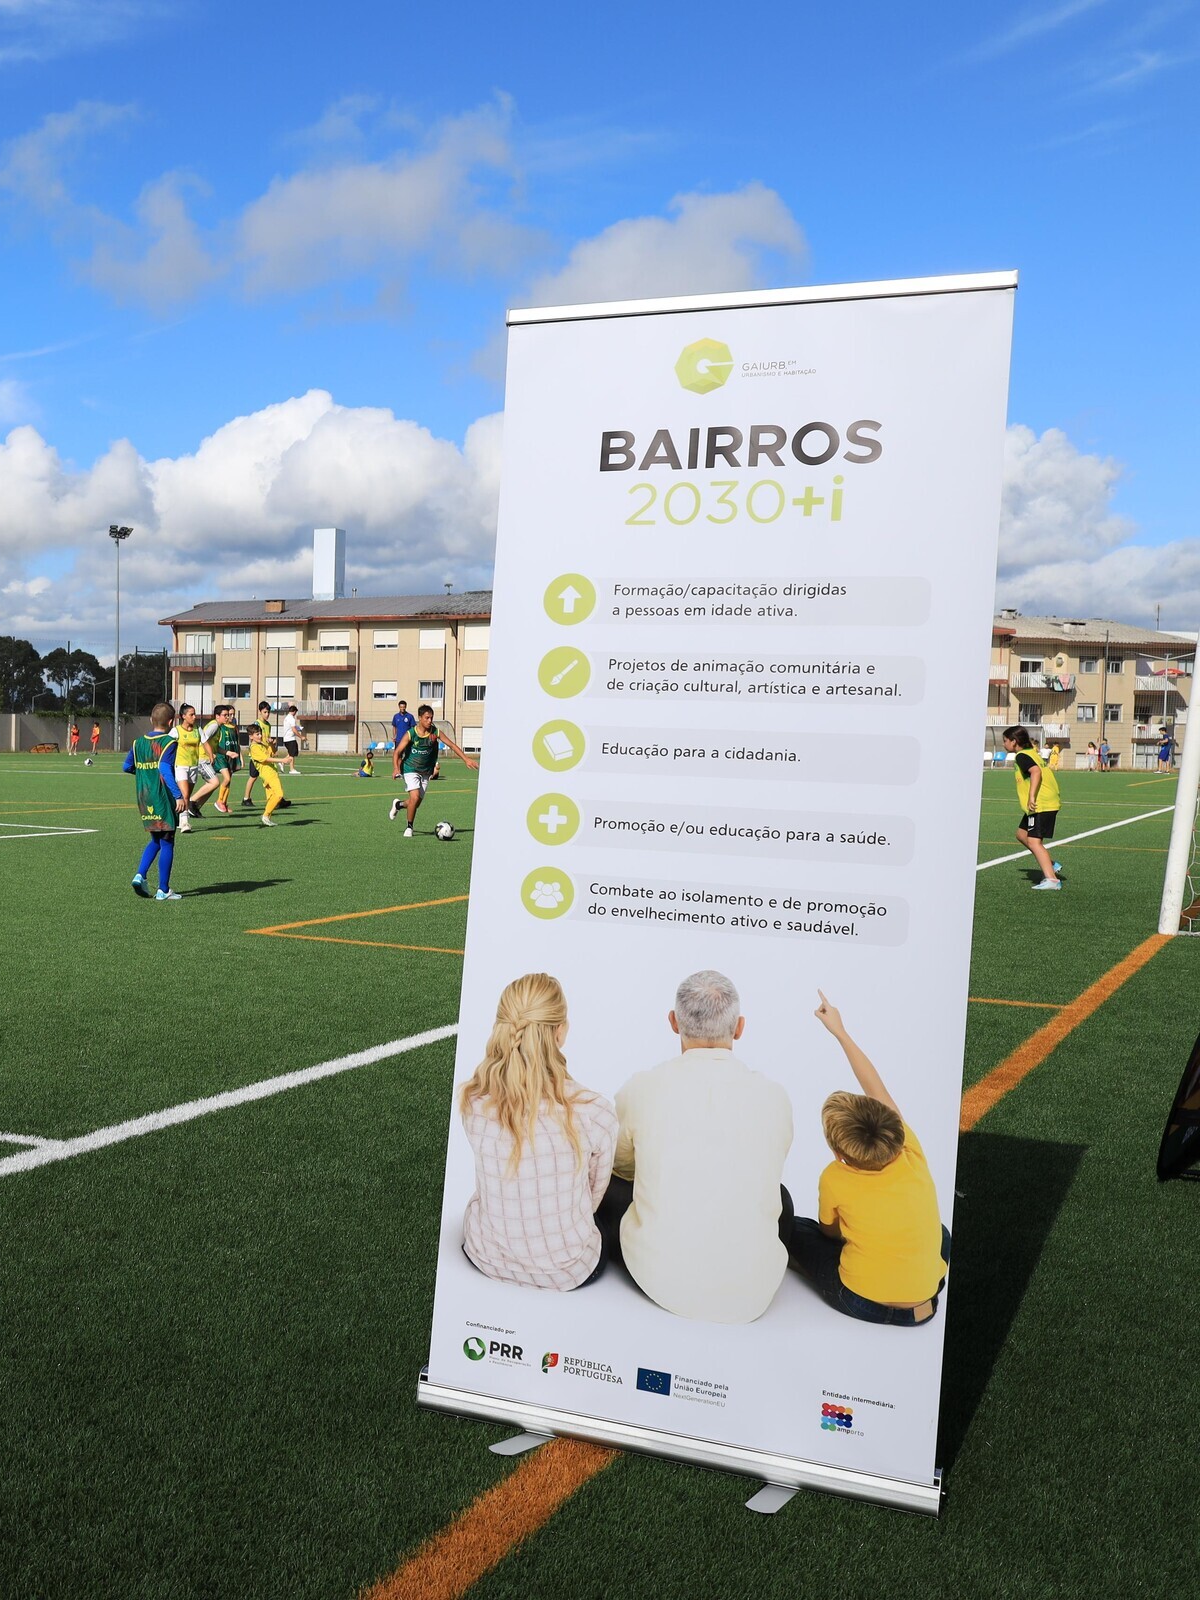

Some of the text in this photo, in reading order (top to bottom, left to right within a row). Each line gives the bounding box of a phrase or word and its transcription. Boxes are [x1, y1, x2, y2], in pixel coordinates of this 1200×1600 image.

[600, 420, 883, 472] BAIRROS
[625, 475, 844, 526] 2030+i
[614, 582, 847, 600] Formação/capacitação dirigidas
[612, 604, 798, 620] a pessoas em idade ativa.
[608, 659, 875, 676] Projetos de animação comunitária e
[607, 679, 902, 697] de criação cultural, artística e artesanal.
[602, 742, 801, 762] Educação para a cidadania.
[594, 817, 891, 846] Promoção e/ou educação para a saúde.
[590, 883, 887, 919] Combate ao isolamento e de promoção
[588, 904, 858, 936] do envelhecimento ativo e saudável.
[466, 1321, 504, 1333] Confinanciado
[489, 1340, 523, 1360] PRR
[564, 1357, 612, 1373] REPÚBLICA
[563, 1366, 623, 1384] PORTUGUESA
[675, 1375, 712, 1387] Financiado
[674, 1383, 726, 1399] União Europeia
[822, 1390, 896, 1409] Entidade intermediária:
[837, 1427, 864, 1436] amporto
